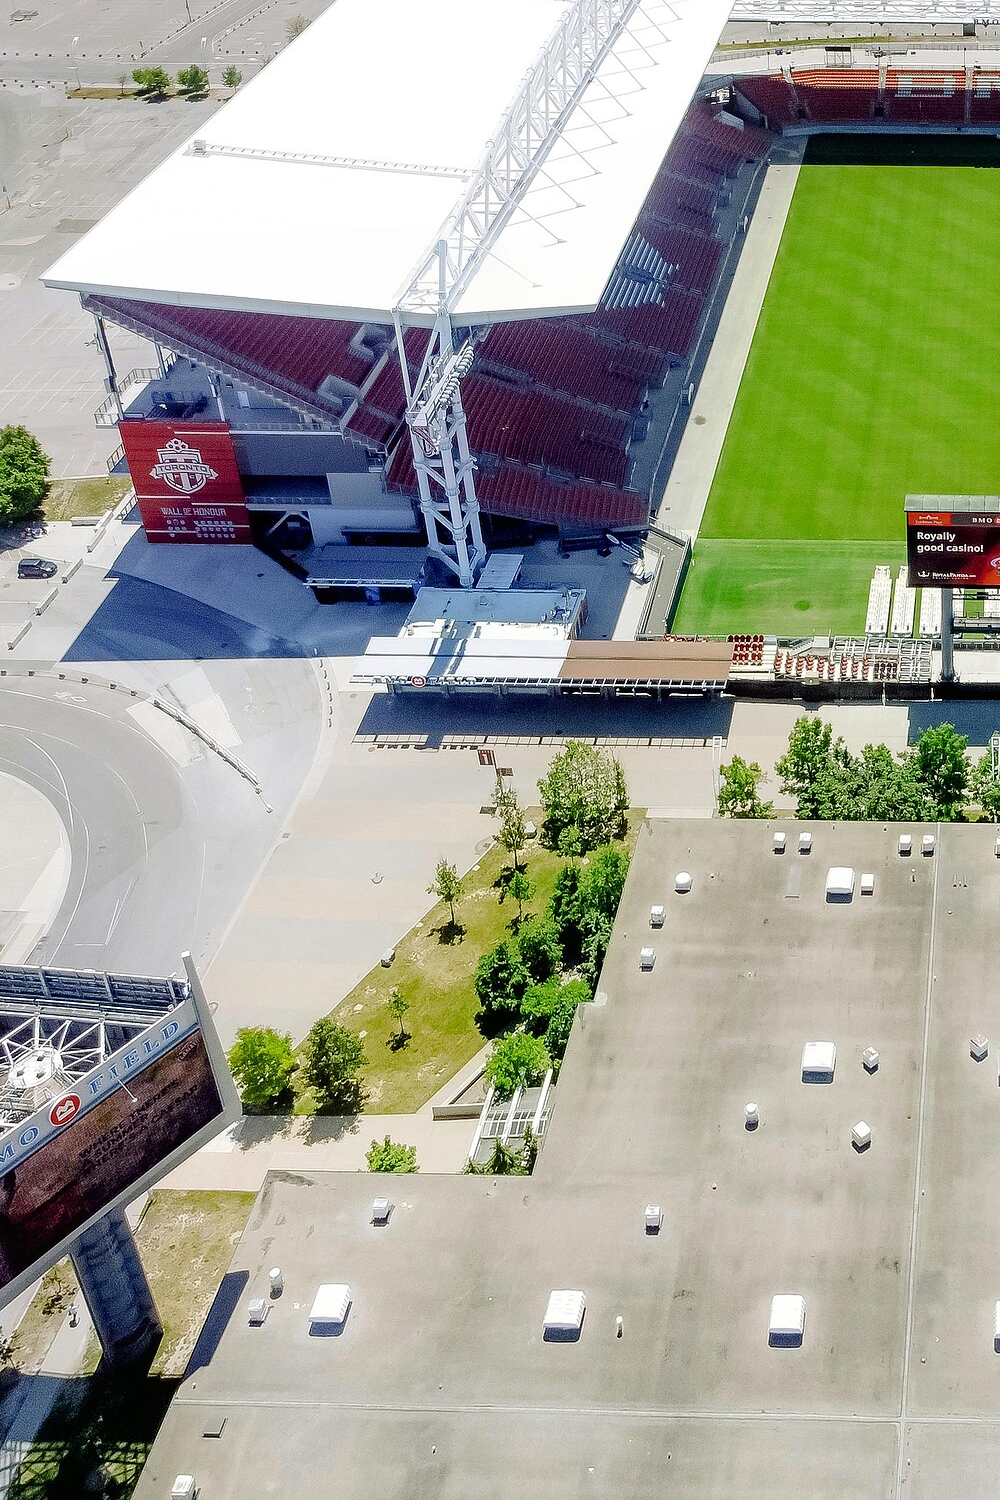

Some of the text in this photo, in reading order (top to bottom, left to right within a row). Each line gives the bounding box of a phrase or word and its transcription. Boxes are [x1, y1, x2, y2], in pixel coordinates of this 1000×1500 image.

[161, 507, 227, 516] WALL OF HONOUR
[917, 531, 956, 542] Royally
[917, 543, 984, 554] good casino!
[89, 1020, 180, 1095] FIELD
